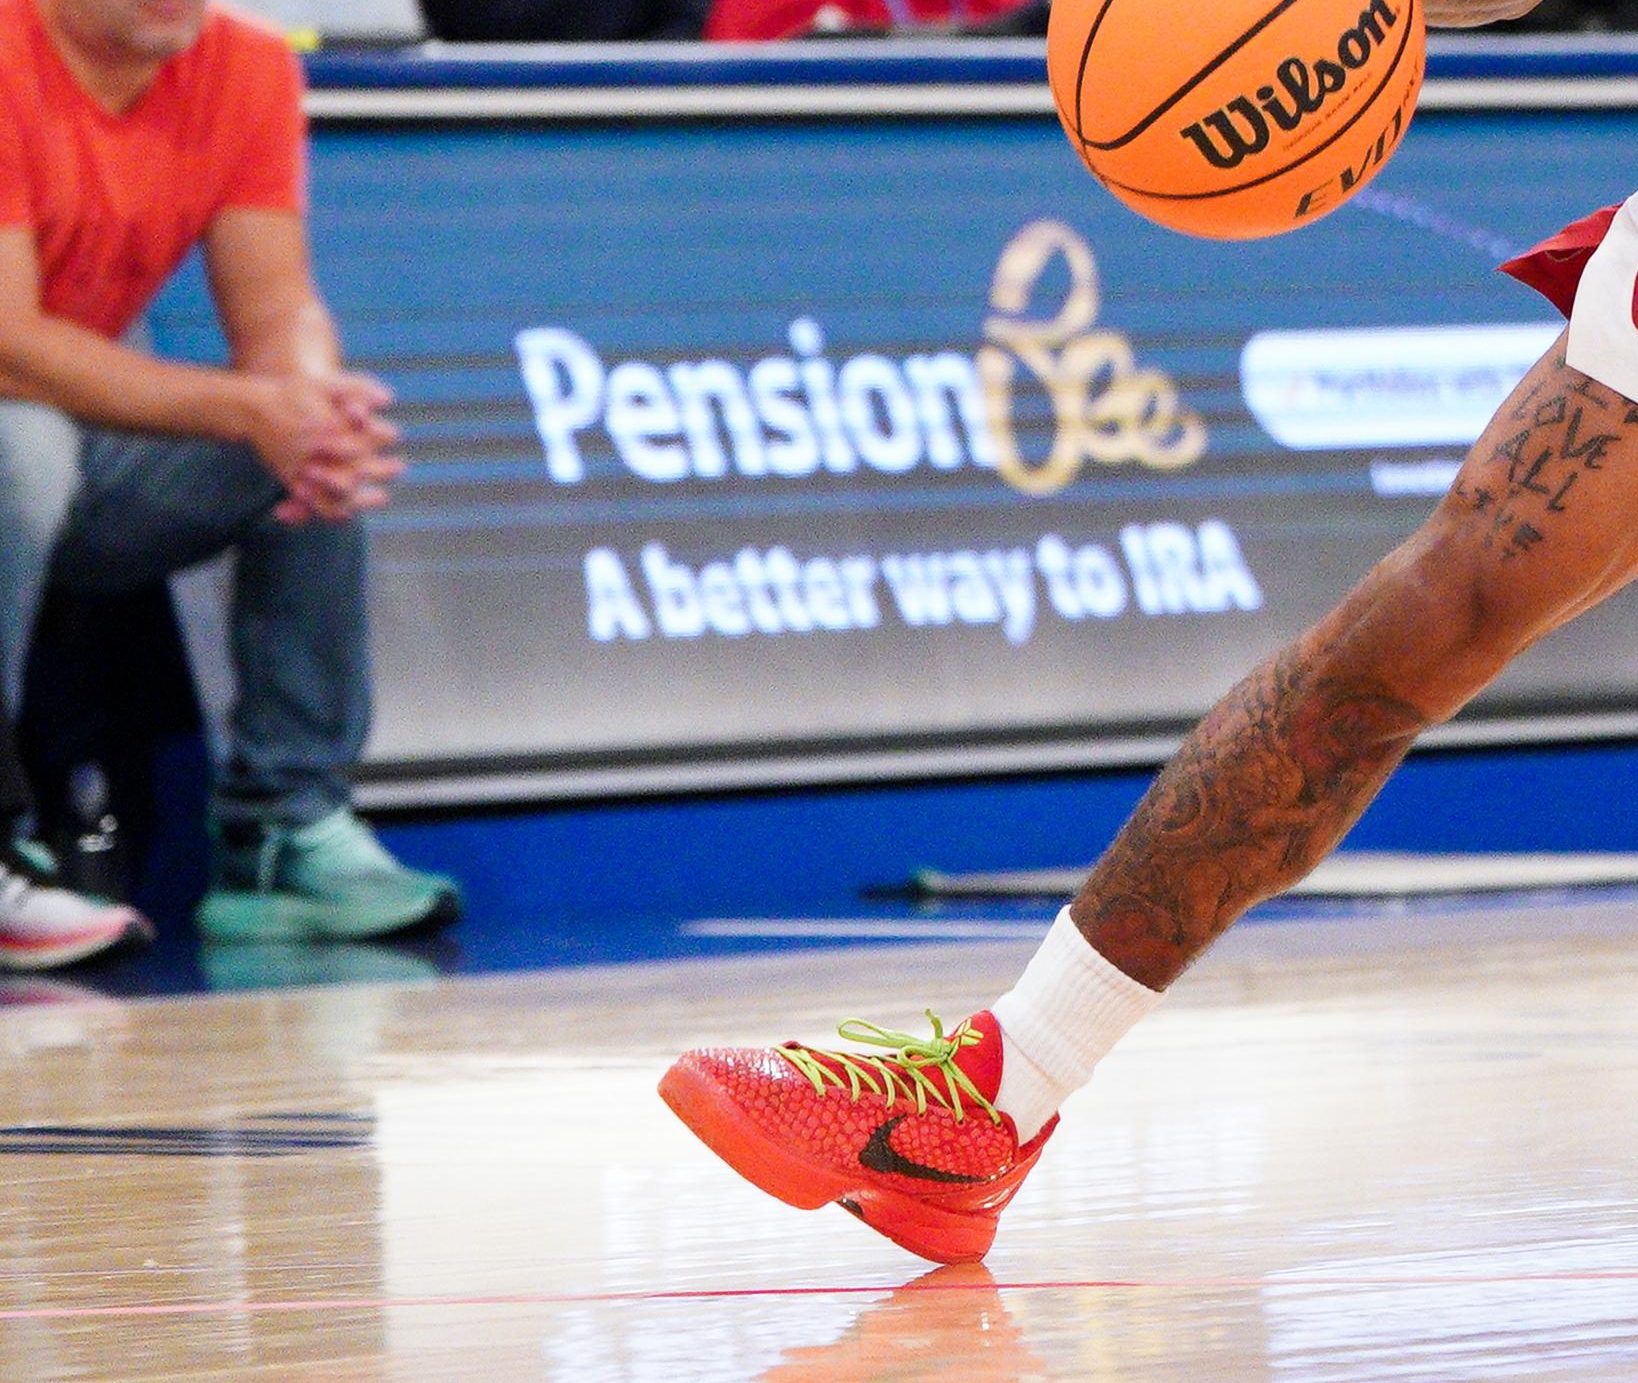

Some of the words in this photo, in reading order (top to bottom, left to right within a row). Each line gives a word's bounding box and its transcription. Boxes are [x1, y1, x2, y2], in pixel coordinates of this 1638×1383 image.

[1486, 429, 1565, 512] ALL
[584, 545, 650, 641] A
[641, 540, 882, 639] better
[880, 548, 1036, 646] way
[1035, 533, 1127, 621] to
[1121, 518, 1264, 616] IRA
